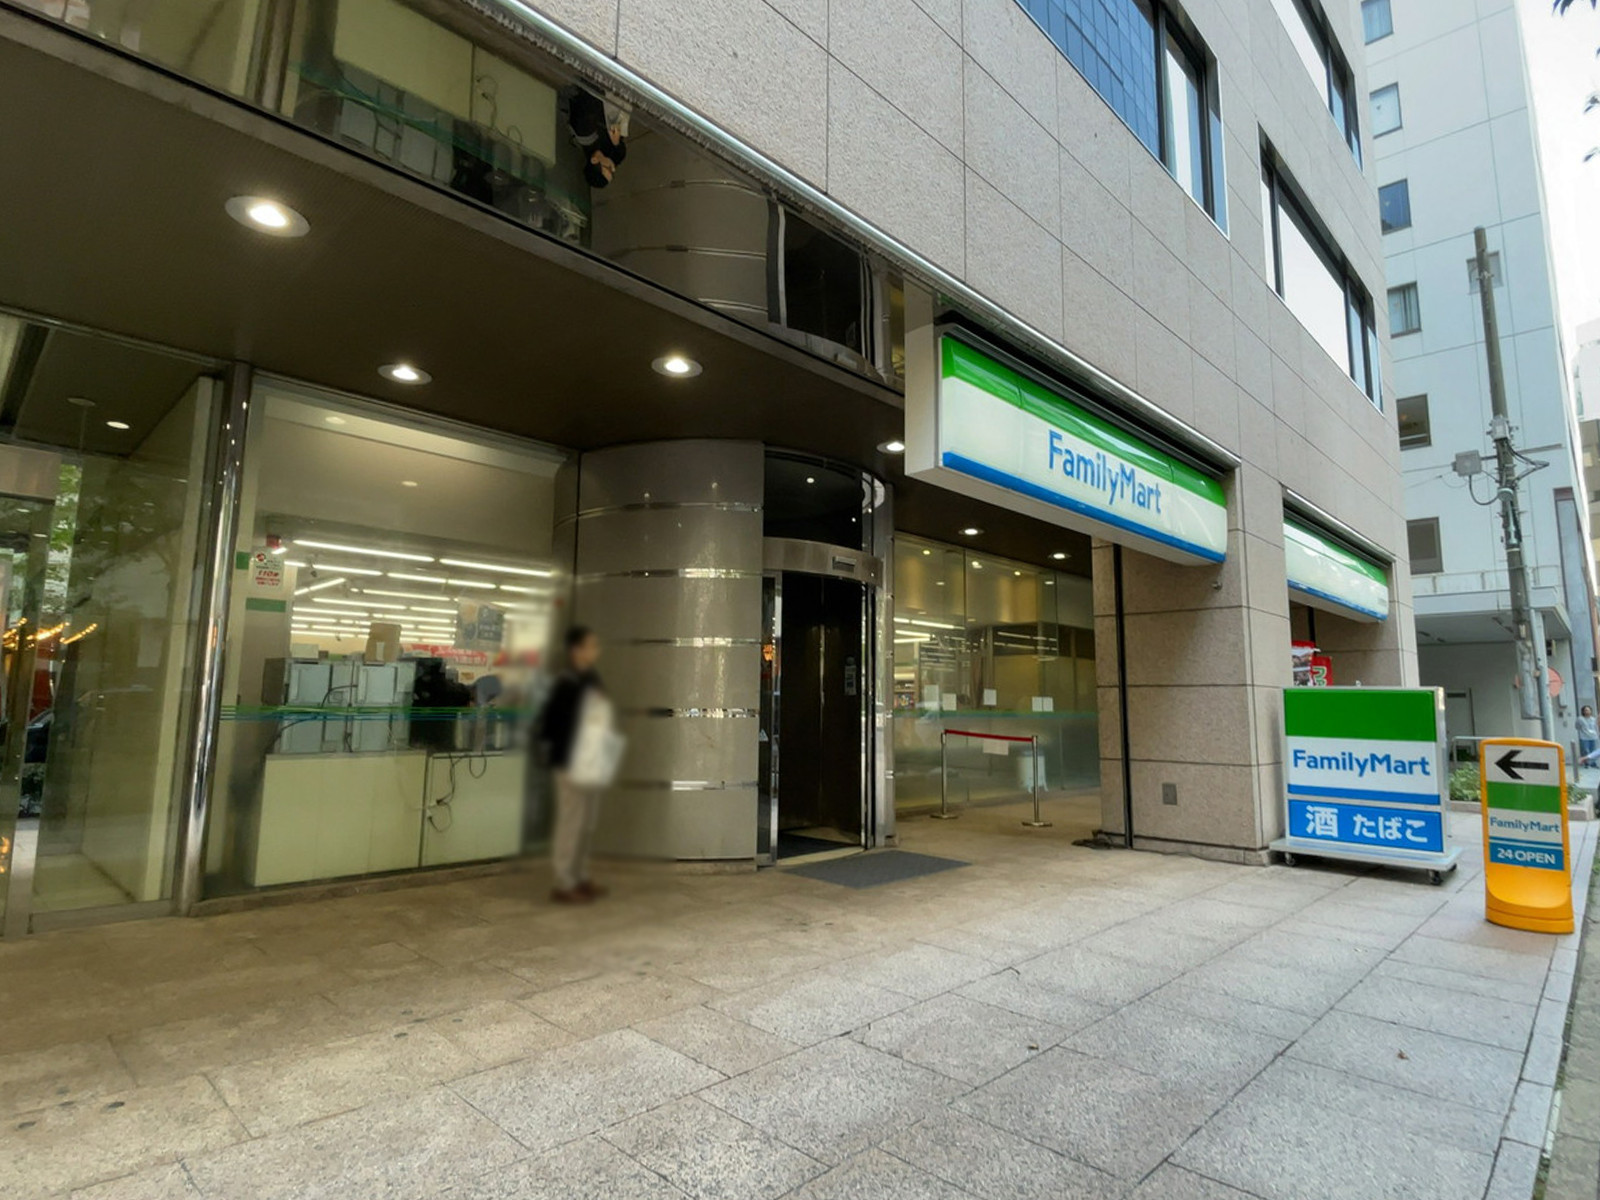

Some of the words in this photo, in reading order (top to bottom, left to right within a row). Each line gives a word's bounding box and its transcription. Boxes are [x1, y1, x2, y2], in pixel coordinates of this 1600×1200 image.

[1049, 429, 1161, 514] FamilyMart
[1293, 749, 1430, 778] FamilyMart
[1306, 805, 1338, 837] 酒
[1353, 813, 1428, 843] たばこ
[1490, 816, 1560, 833] FamilyMart
[1514, 849, 1556, 865] OPEN
